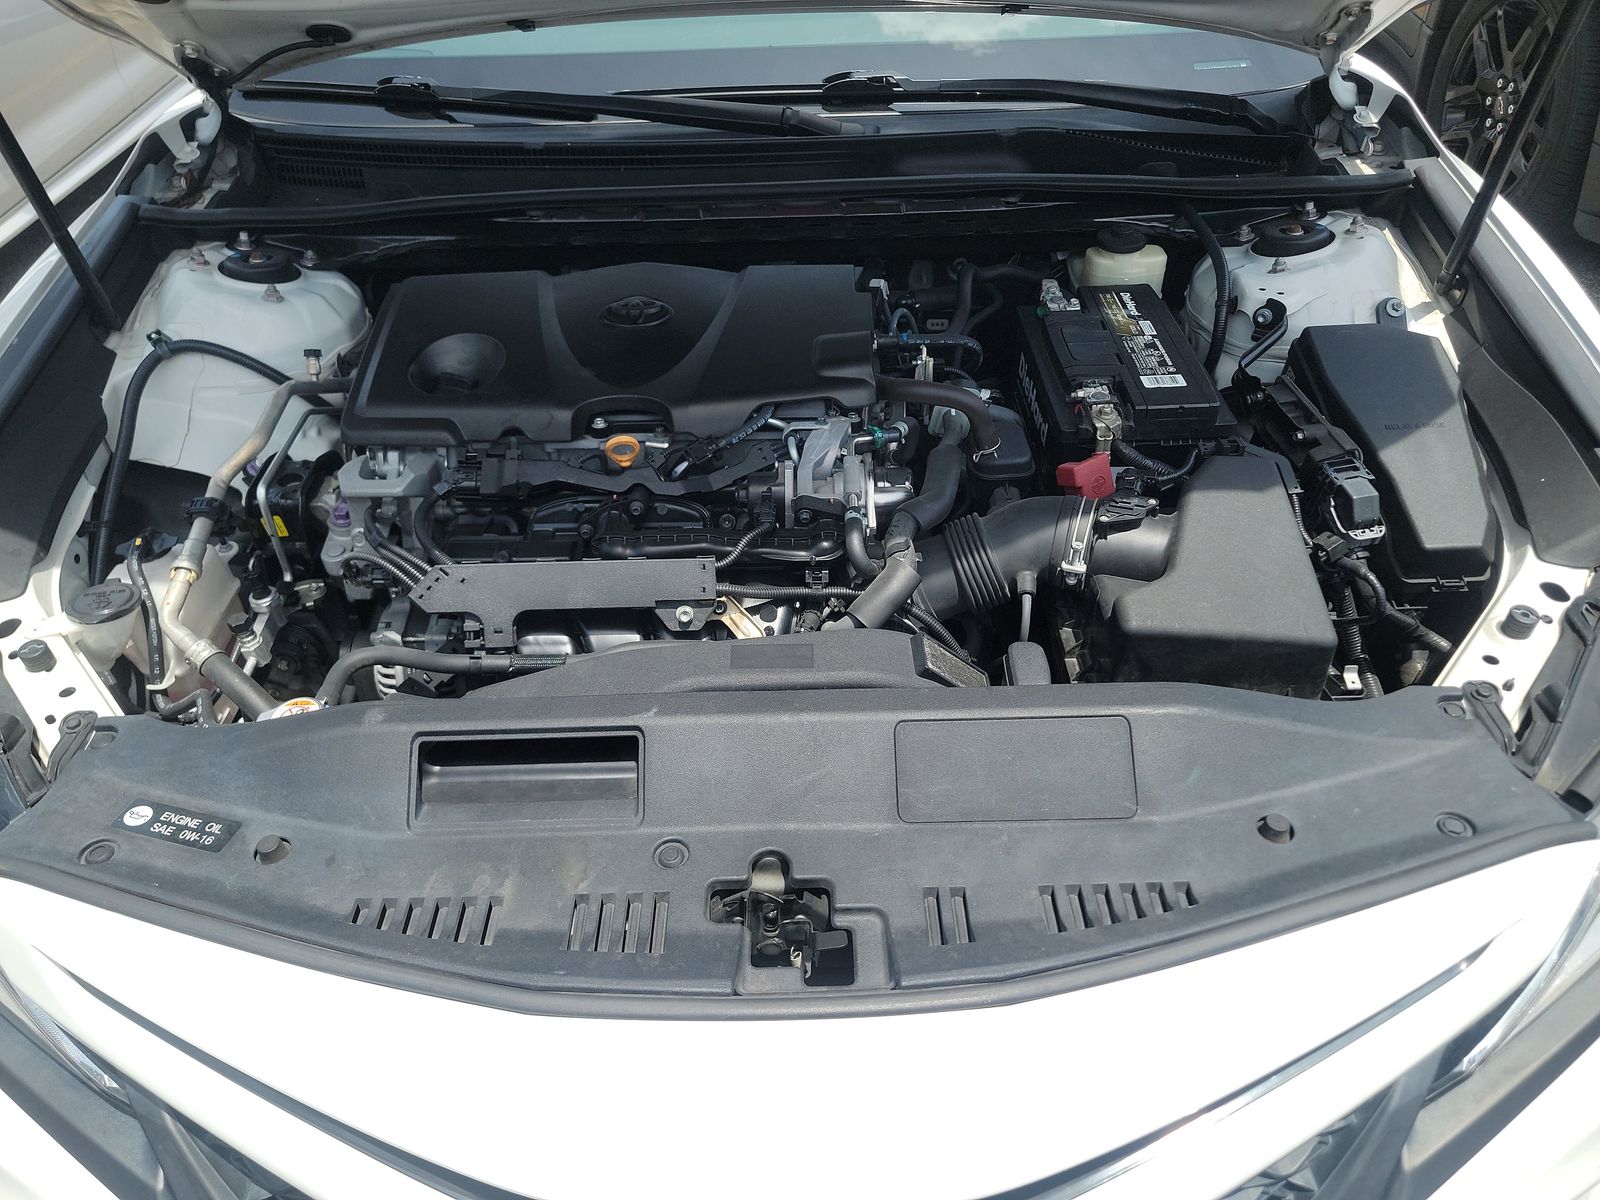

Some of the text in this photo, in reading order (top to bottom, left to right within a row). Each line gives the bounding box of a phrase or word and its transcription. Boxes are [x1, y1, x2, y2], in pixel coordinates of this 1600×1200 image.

[1120, 292, 1142, 316] DieHard
[1019, 352, 1048, 447] DieHard
[150, 822, 215, 846] SAE 0W-16
[160, 811, 223, 834] ENGINE OIL
